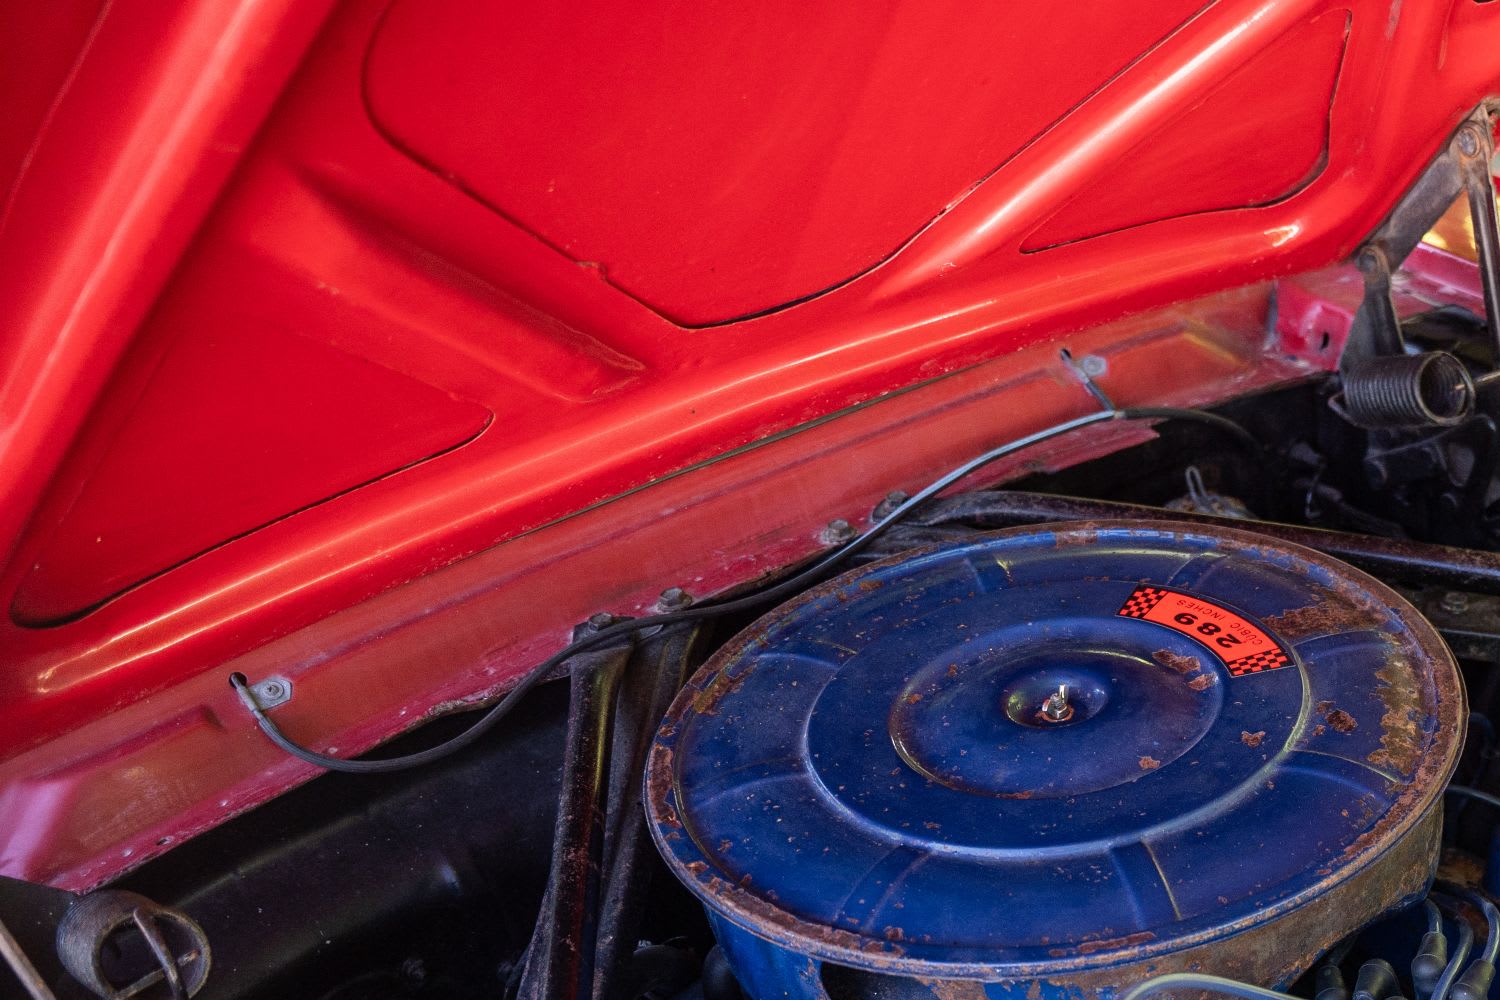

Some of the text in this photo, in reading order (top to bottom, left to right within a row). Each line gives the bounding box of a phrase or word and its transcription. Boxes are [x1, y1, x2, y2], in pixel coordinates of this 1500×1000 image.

[1174, 612, 1243, 649] 289
[1177, 599, 1263, 645] CUBIC INCHES
